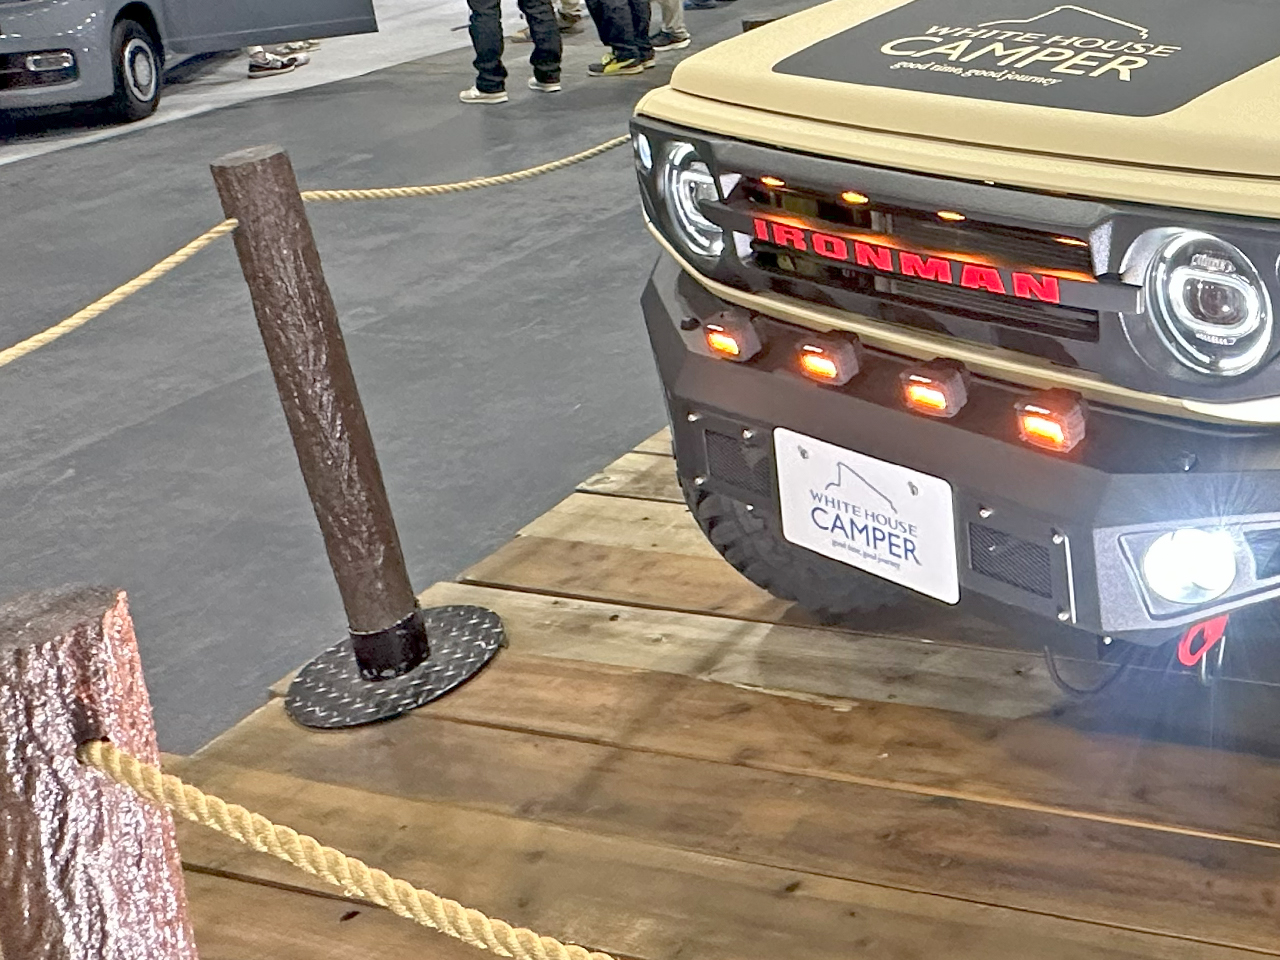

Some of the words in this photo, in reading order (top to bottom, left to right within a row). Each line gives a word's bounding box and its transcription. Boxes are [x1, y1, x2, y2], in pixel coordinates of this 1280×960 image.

[880, 35, 1150, 82] CAMPER
[925, 25, 1047, 44] WHITE
[1043, 35, 1182, 57] HOUSE
[890, 60, 930, 71] good
[930, 61, 965, 75] time,
[961, 66, 1005, 78] good
[1002, 70, 1063, 86] journey
[753, 219, 1061, 304] IRONMAN
[809, 489, 861, 517] WHITE
[864, 510, 917, 538] HOUSE
[811, 507, 922, 566] CAMPER
